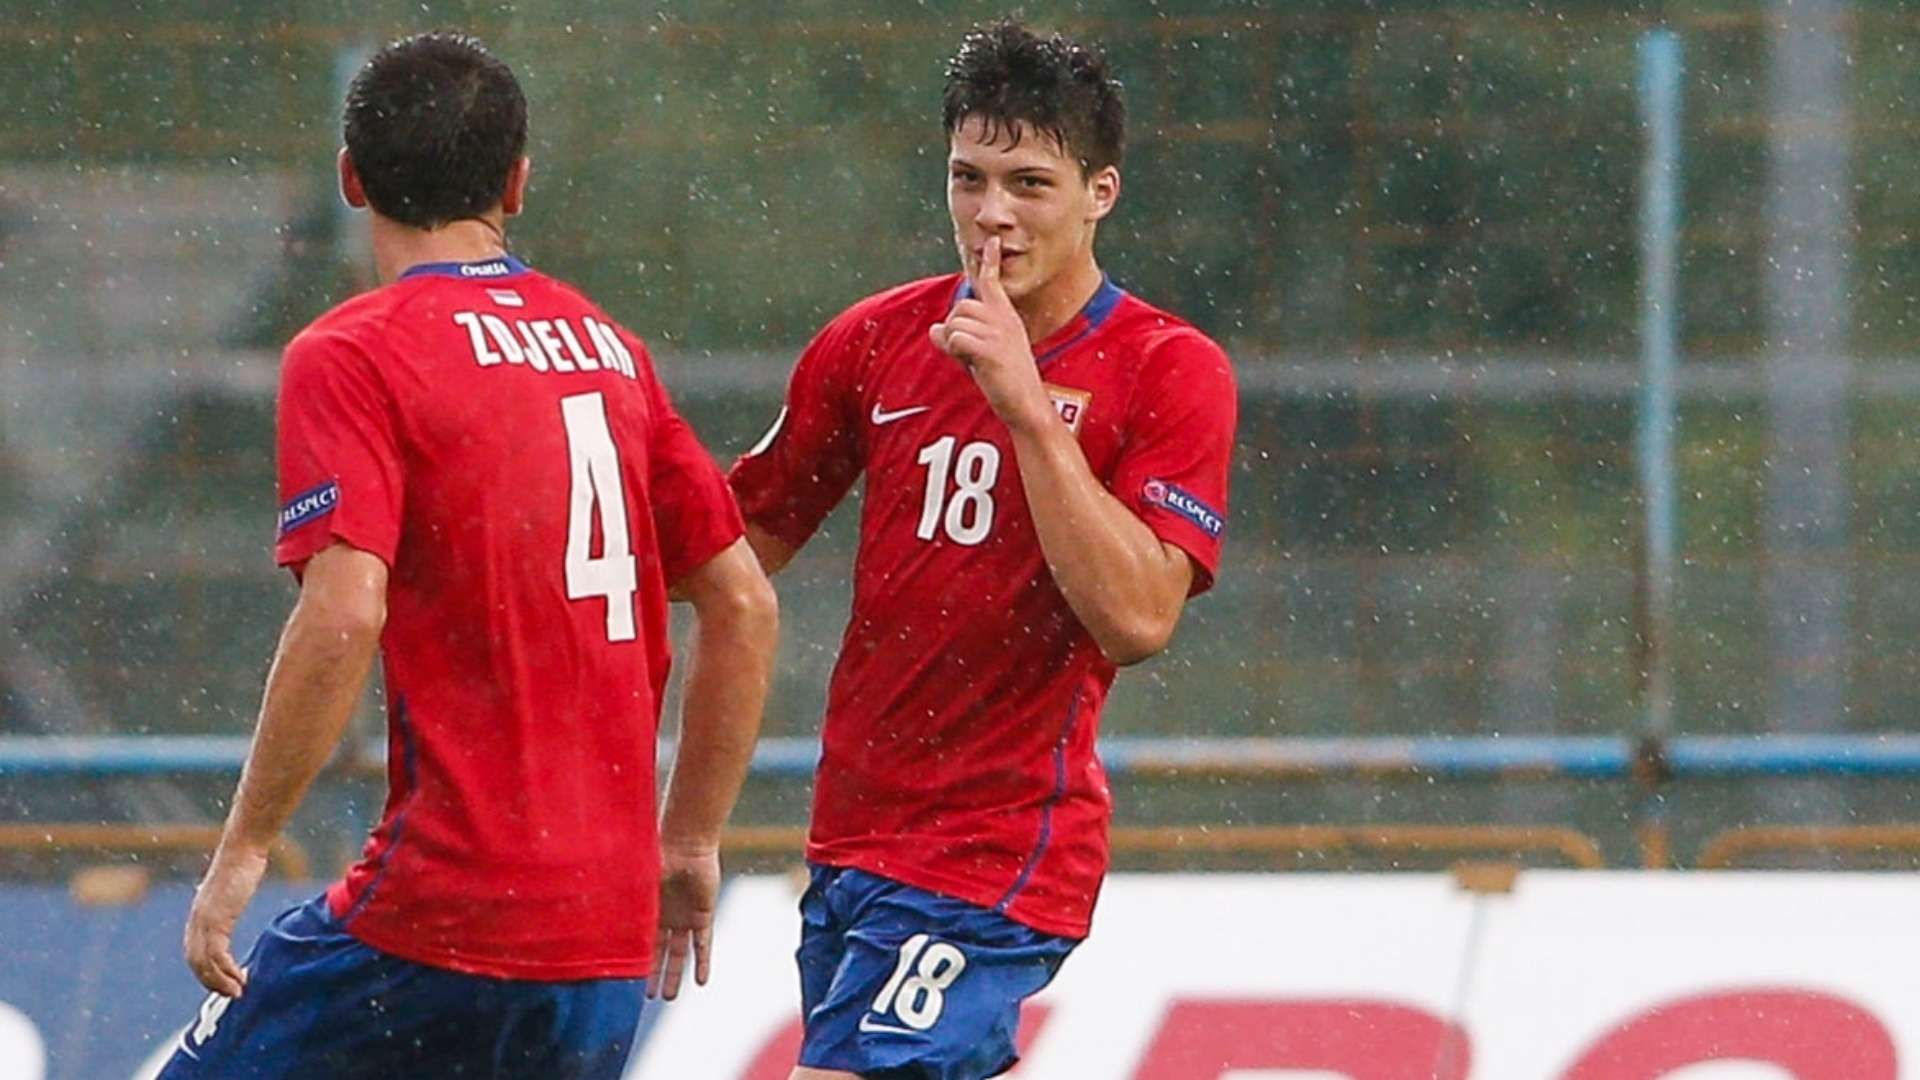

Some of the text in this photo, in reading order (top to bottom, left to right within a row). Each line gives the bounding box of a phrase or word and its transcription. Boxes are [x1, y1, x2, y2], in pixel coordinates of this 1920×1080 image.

[561, 391, 637, 642] 4
[917, 435, 1000, 545] 18
[1167, 491, 1222, 533] RESPECT
[871, 933, 966, 1030] 18
